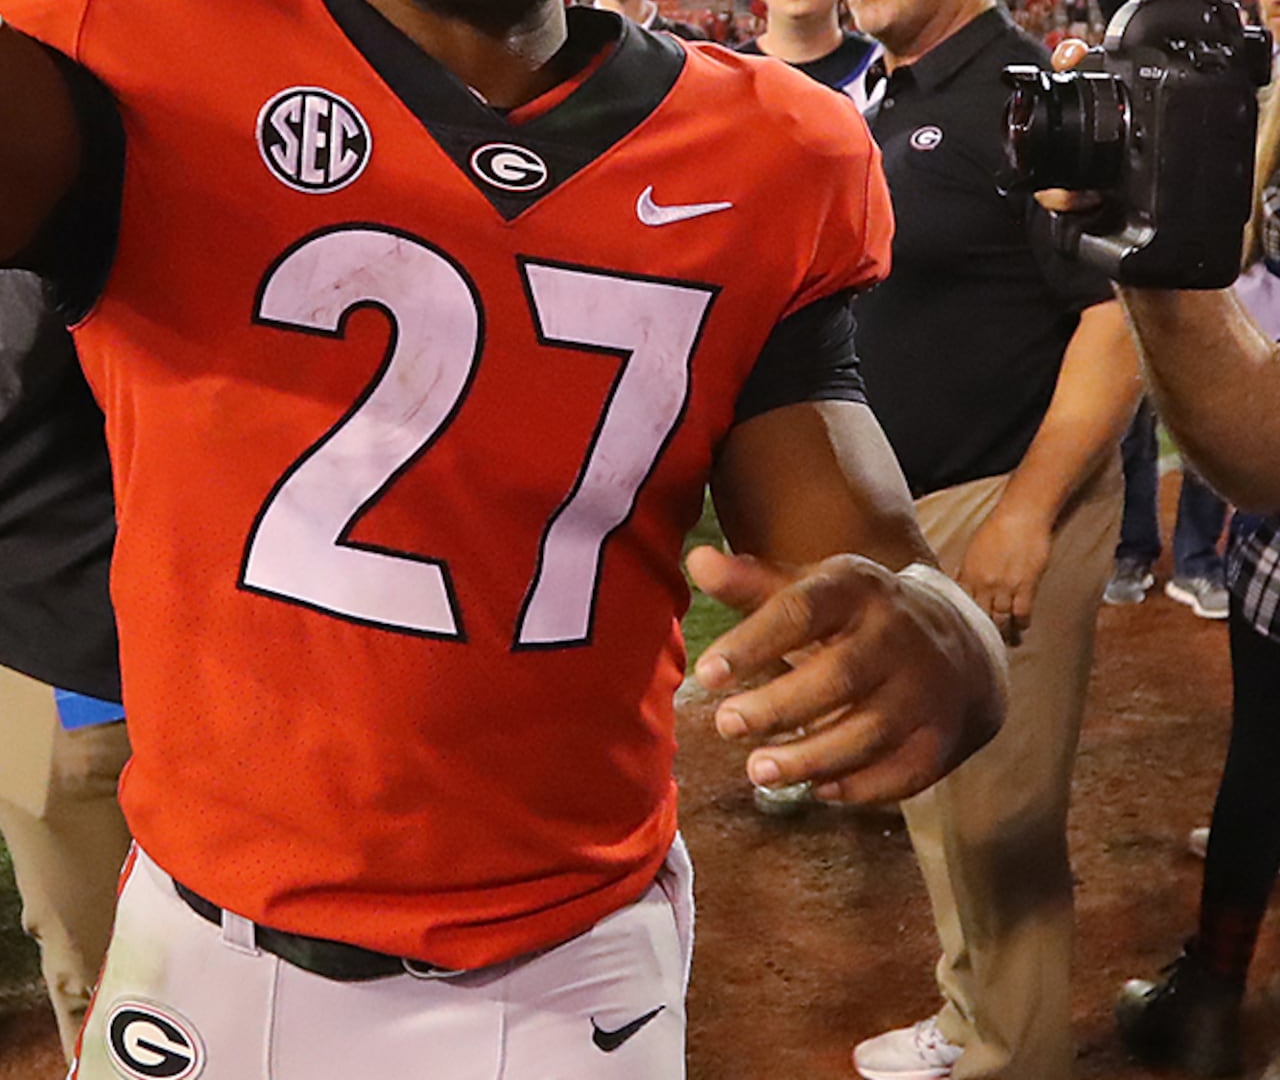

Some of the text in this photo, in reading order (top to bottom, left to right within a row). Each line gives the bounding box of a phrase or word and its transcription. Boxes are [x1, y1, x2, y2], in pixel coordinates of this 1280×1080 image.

[270, 94, 360, 183] SEC
[472, 145, 547, 190] G
[911, 126, 942, 150] G
[236, 221, 723, 653] 27
[109, 1007, 194, 1078] G
